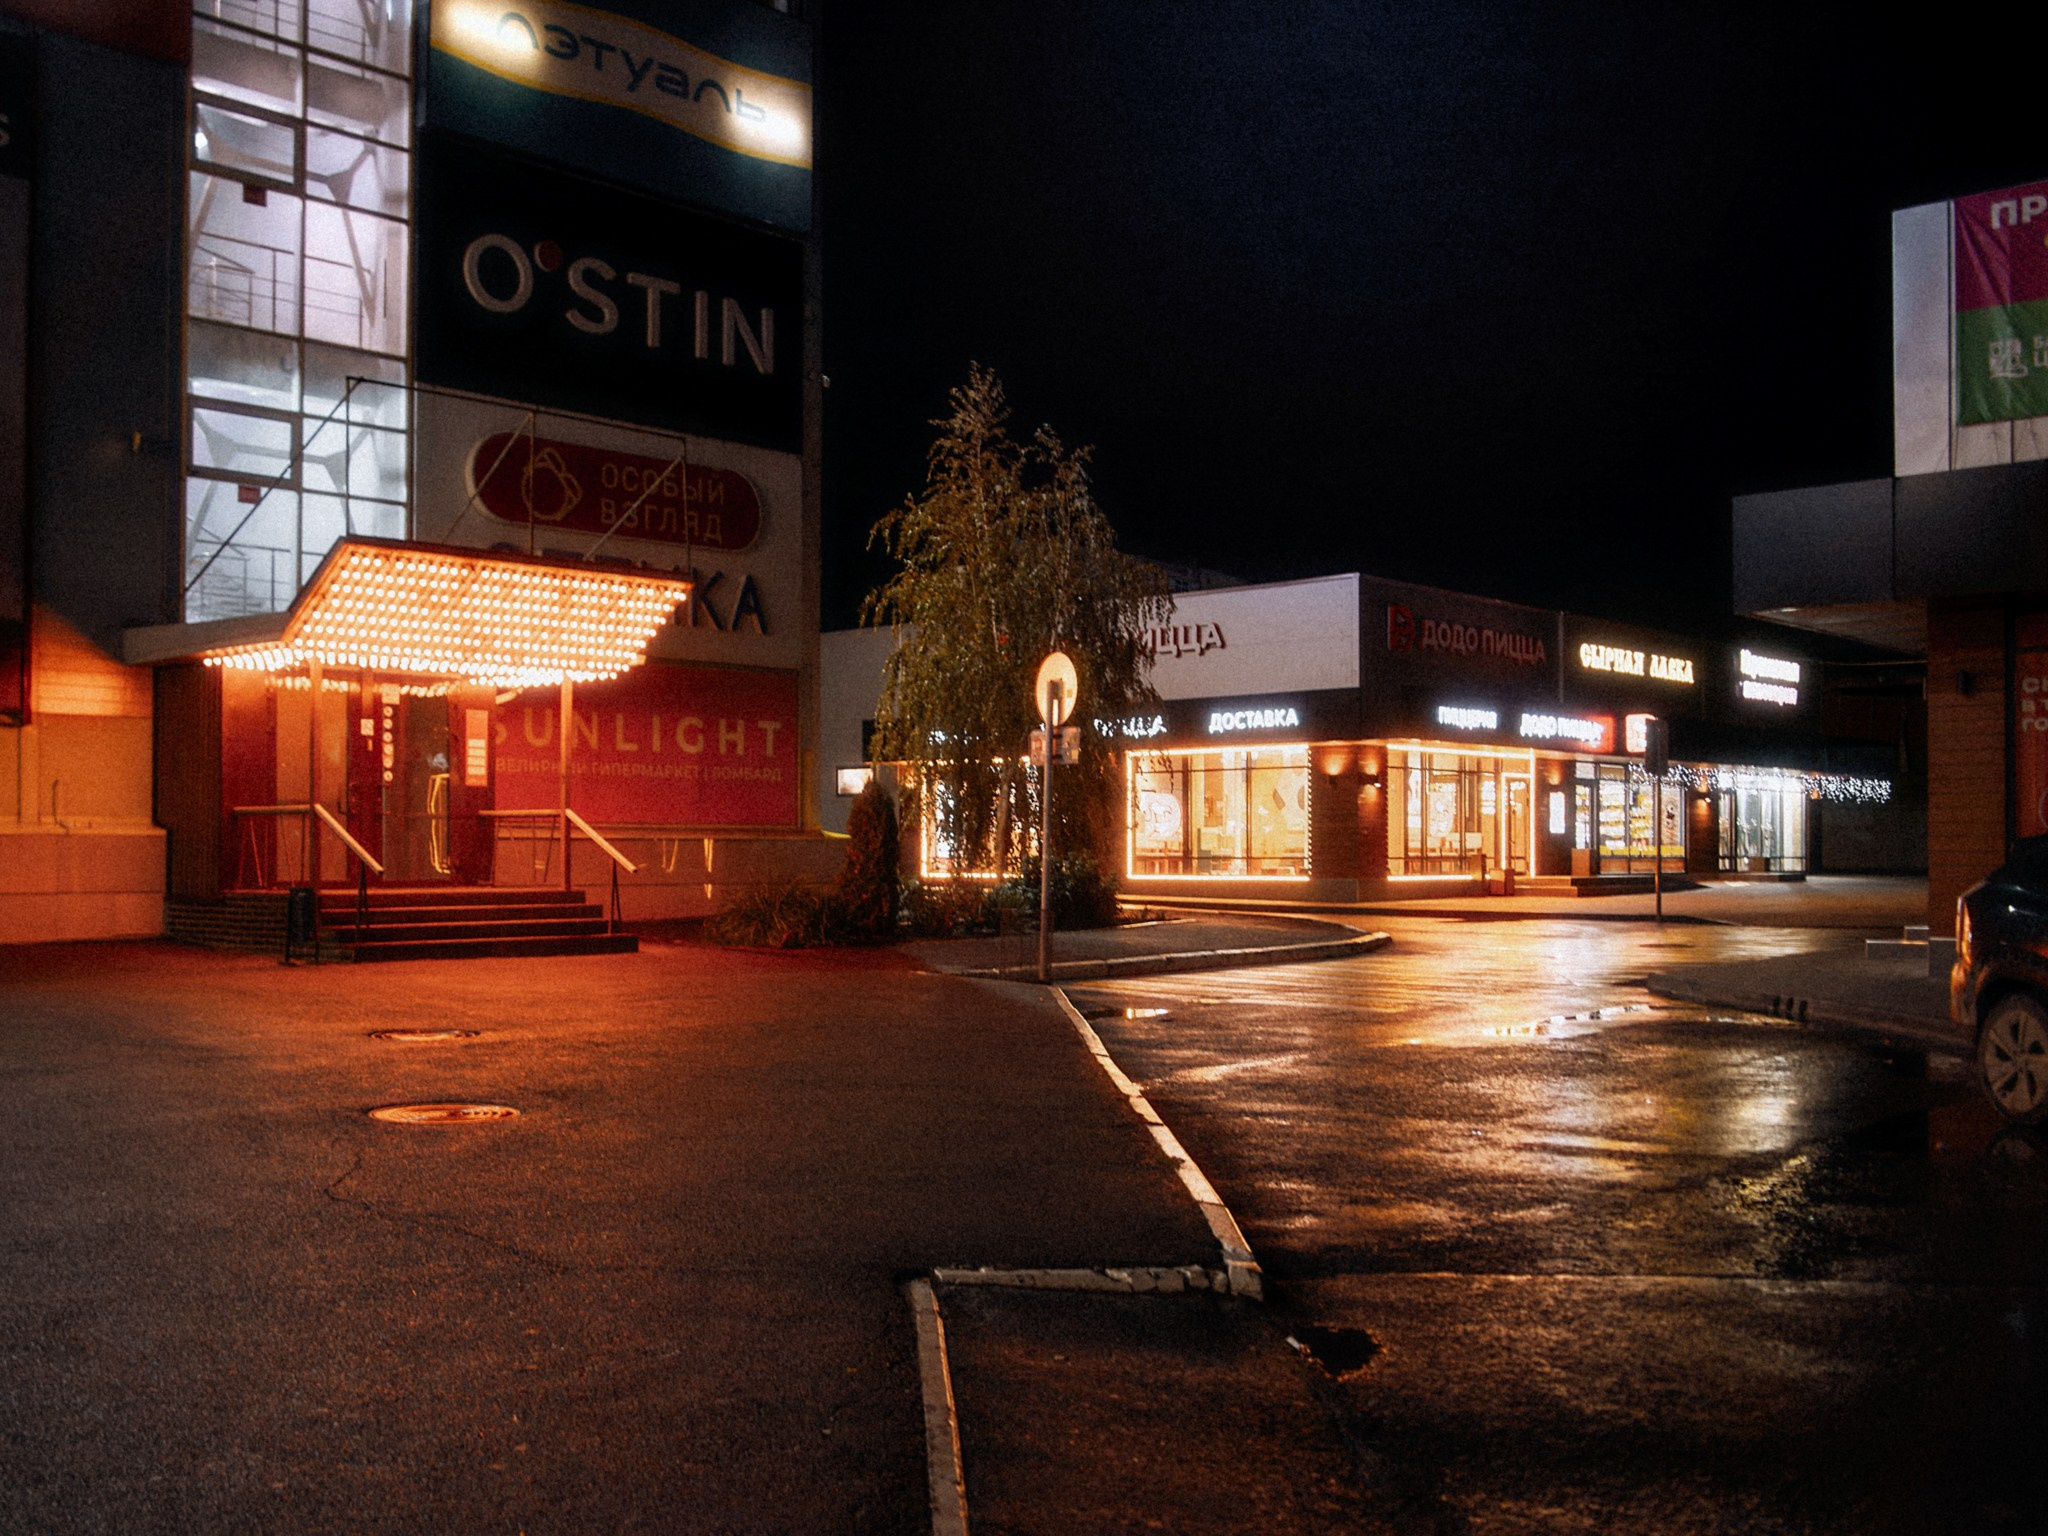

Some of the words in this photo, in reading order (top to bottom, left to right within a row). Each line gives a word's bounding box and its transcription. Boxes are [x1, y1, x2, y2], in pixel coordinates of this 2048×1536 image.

[600, 461, 725, 506] ОСОБЫЙ
[600, 497, 723, 545] ВЗГЛЯД
[1130, 622, 1227, 658] ИЦЦА
[1421, 619, 1479, 656] ДОДО
[1481, 627, 1546, 665] ПИЦЦА
[1579, 642, 1646, 676] СЫРНАЯ
[1208, 707, 1299, 734] ДОСТАВКА
[1437, 706, 1498, 730] ПИЦЦЕРИЯ
[1519, 713, 1557, 739] ДОДО
[711, 765, 782, 782] ЛОМБАРД
